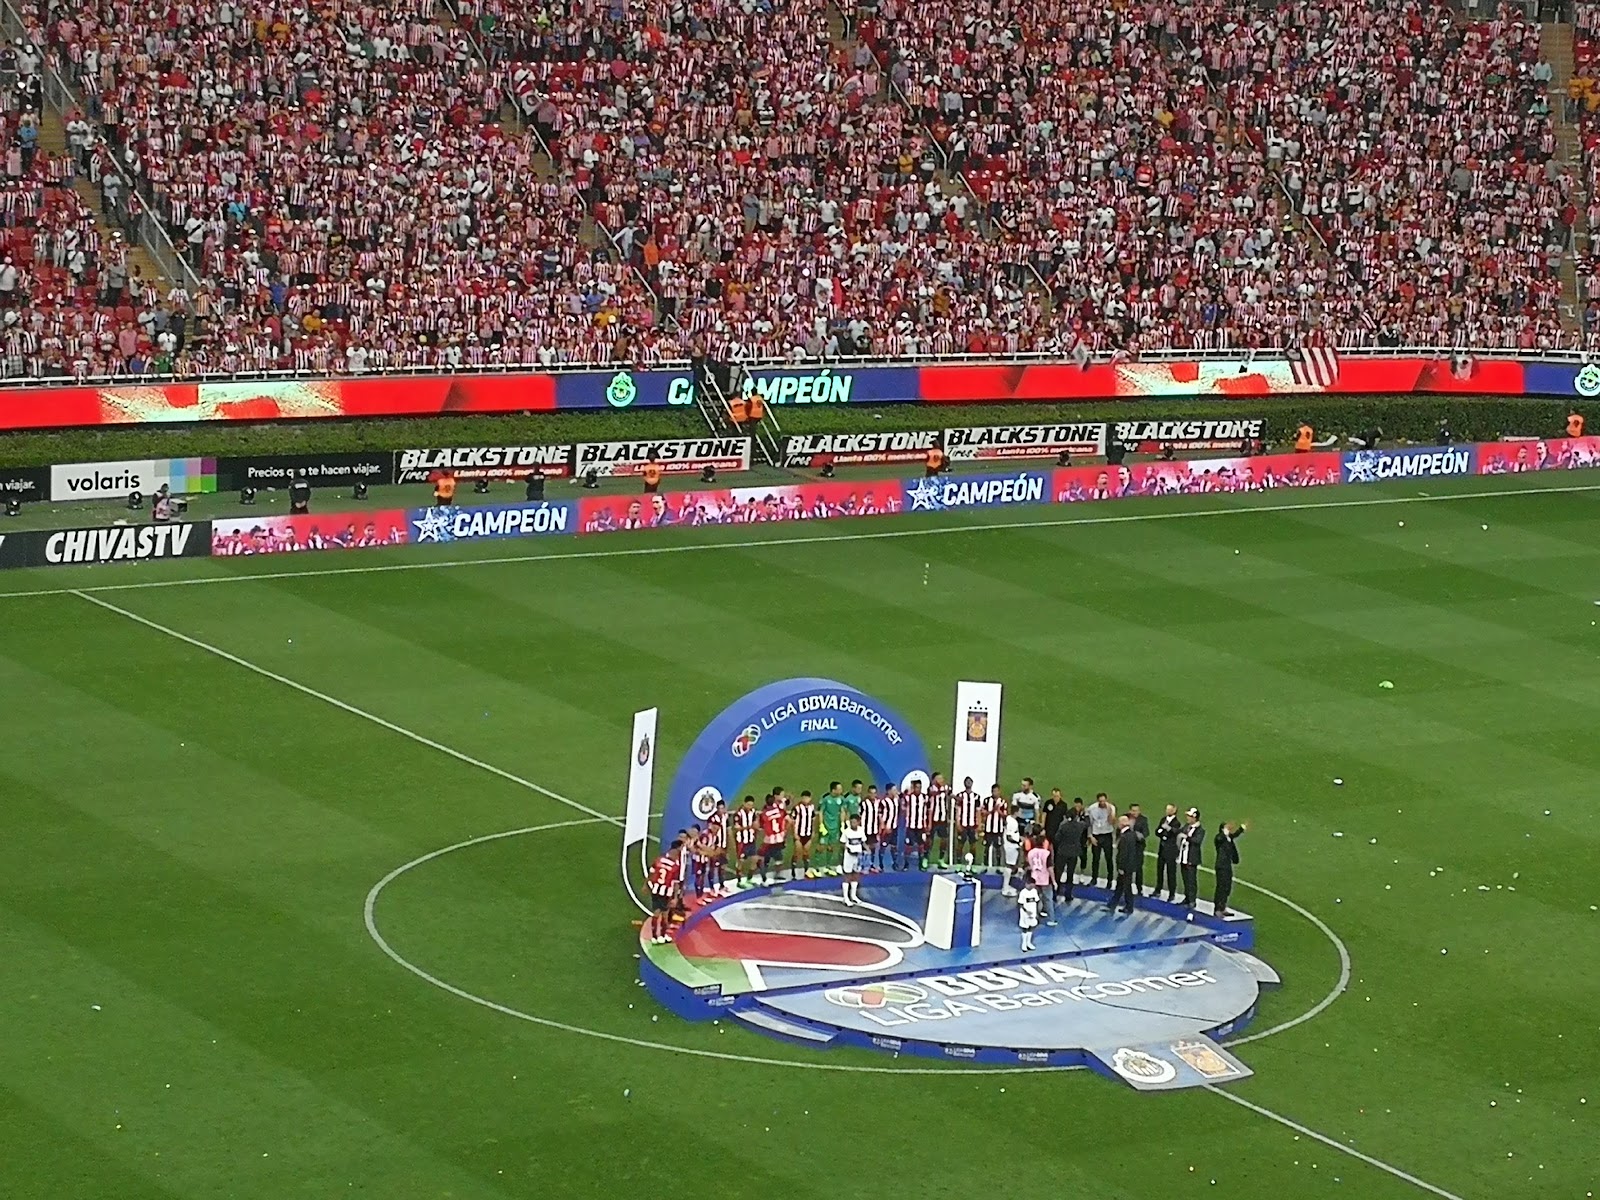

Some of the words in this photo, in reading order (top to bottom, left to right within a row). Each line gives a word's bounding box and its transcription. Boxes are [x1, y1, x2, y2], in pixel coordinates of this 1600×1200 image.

[947, 425, 1102, 446] BLACKSTONE
[1115, 419, 1263, 440] BLACKSTONE
[581, 439, 746, 462] BLACKSTONE
[786, 431, 939, 454] BLACKSTONE
[400, 444, 571, 468] BLACKSTONE
[1376, 447, 1470, 478] CAMPEÓN
[67, 469, 141, 492] volaris
[247, 466, 285, 479] Precios
[286, 467, 307, 479] qe
[308, 466, 319, 477] te
[320, 464, 351, 476] hacen
[352, 463, 381, 477] viajar.
[5, 478, 36, 493] viajar.
[942, 472, 1044, 506] CAMPEÓN
[453, 502, 568, 538] CAMPEÓN
[45, 524, 193, 563] CHIVASTV
[760, 702, 798, 731] LIGA
[798, 694, 838, 713] BBVA
[838, 695, 903, 746] Bancomer
[800, 717, 839, 732] FINAL
[657, 868, 667, 885] 3
[916, 961, 1100, 997] BBVA
[859, 999, 988, 1027] LIGA
[974, 969, 1217, 1011] Bancomer
